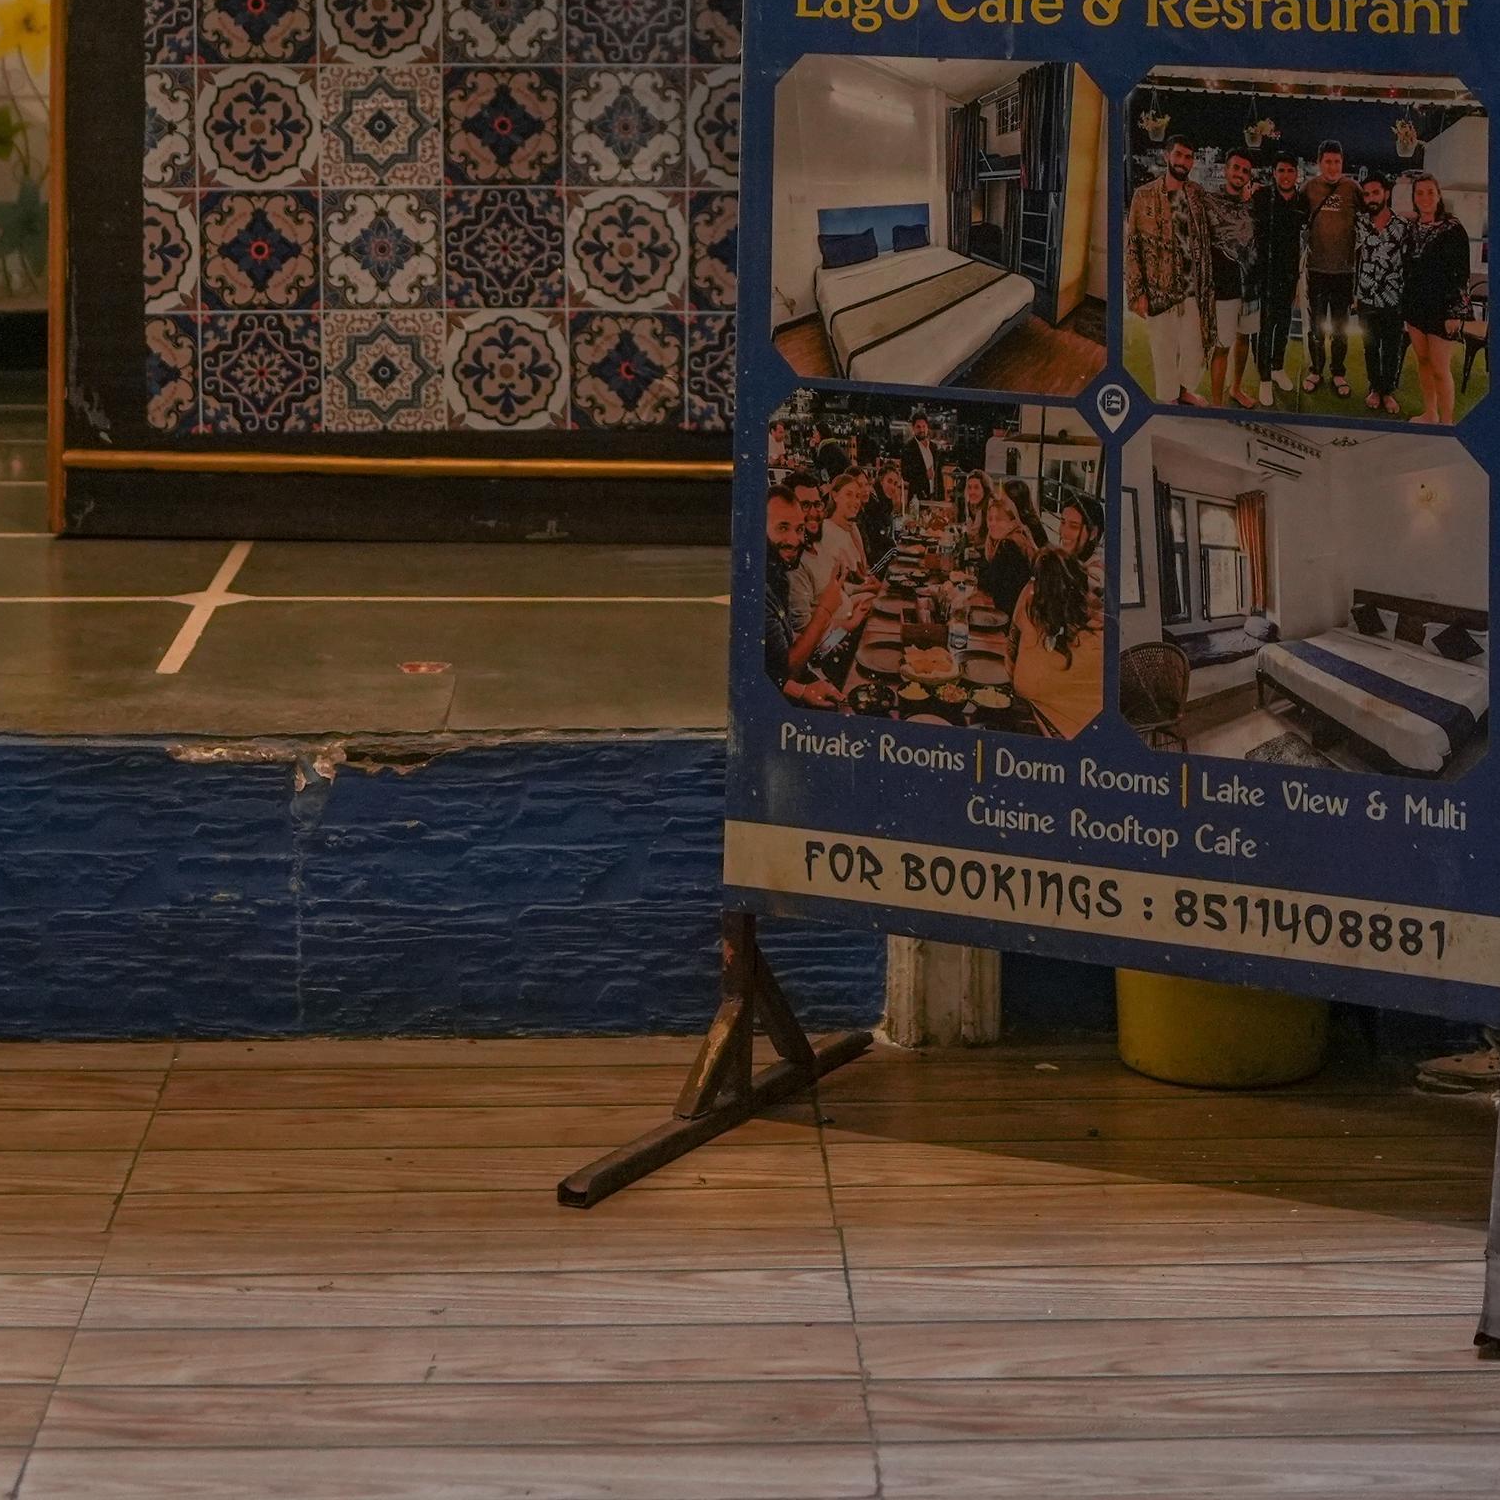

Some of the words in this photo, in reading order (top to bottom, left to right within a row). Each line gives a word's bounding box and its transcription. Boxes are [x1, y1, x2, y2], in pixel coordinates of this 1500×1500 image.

[780, 723, 864, 756] Private
[879, 734, 965, 772] Rooms
[996, 749, 1065, 785] Dorm
[1080, 758, 1170, 796] Rooms
[1203, 772, 1265, 808] Lake
[1283, 781, 1348, 819] View
[1367, 792, 1387, 820] &
[1404, 793, 1466, 831] Multi
[967, 796, 1054, 836] Cuisine
[1070, 810, 1179, 858] Rooftop
[1195, 824, 1258, 859] Cafe
[804, 840, 882, 890] FOR
[902, 853, 1122, 920] BOOKINGS
[1174, 889, 1447, 960] 8511408881
